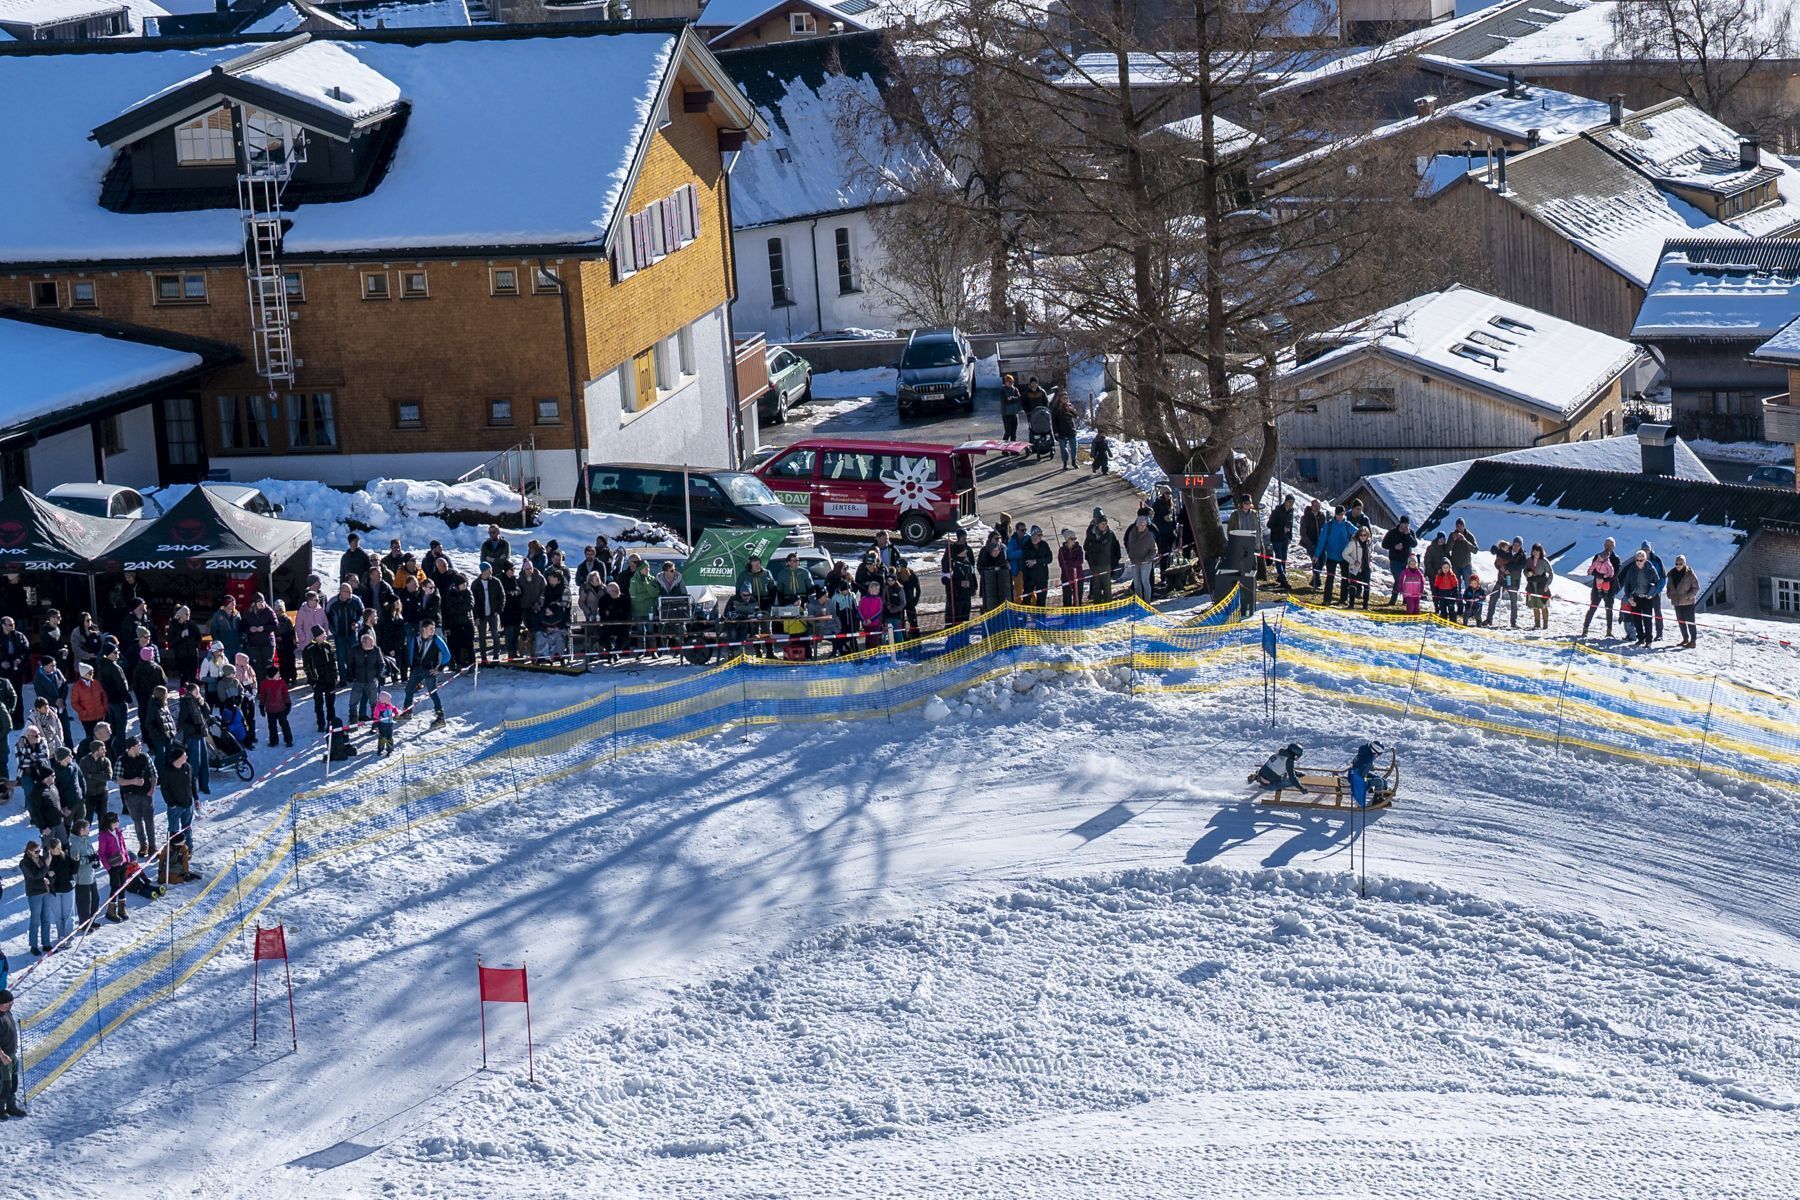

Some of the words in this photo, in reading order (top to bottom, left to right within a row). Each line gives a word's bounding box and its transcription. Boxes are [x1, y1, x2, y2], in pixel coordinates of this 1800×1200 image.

[785, 493, 809, 504] DAV
[25, 562, 75, 571] 24MX
[124, 560, 175, 571] 24MX
[205, 559, 257, 569] 24MX
